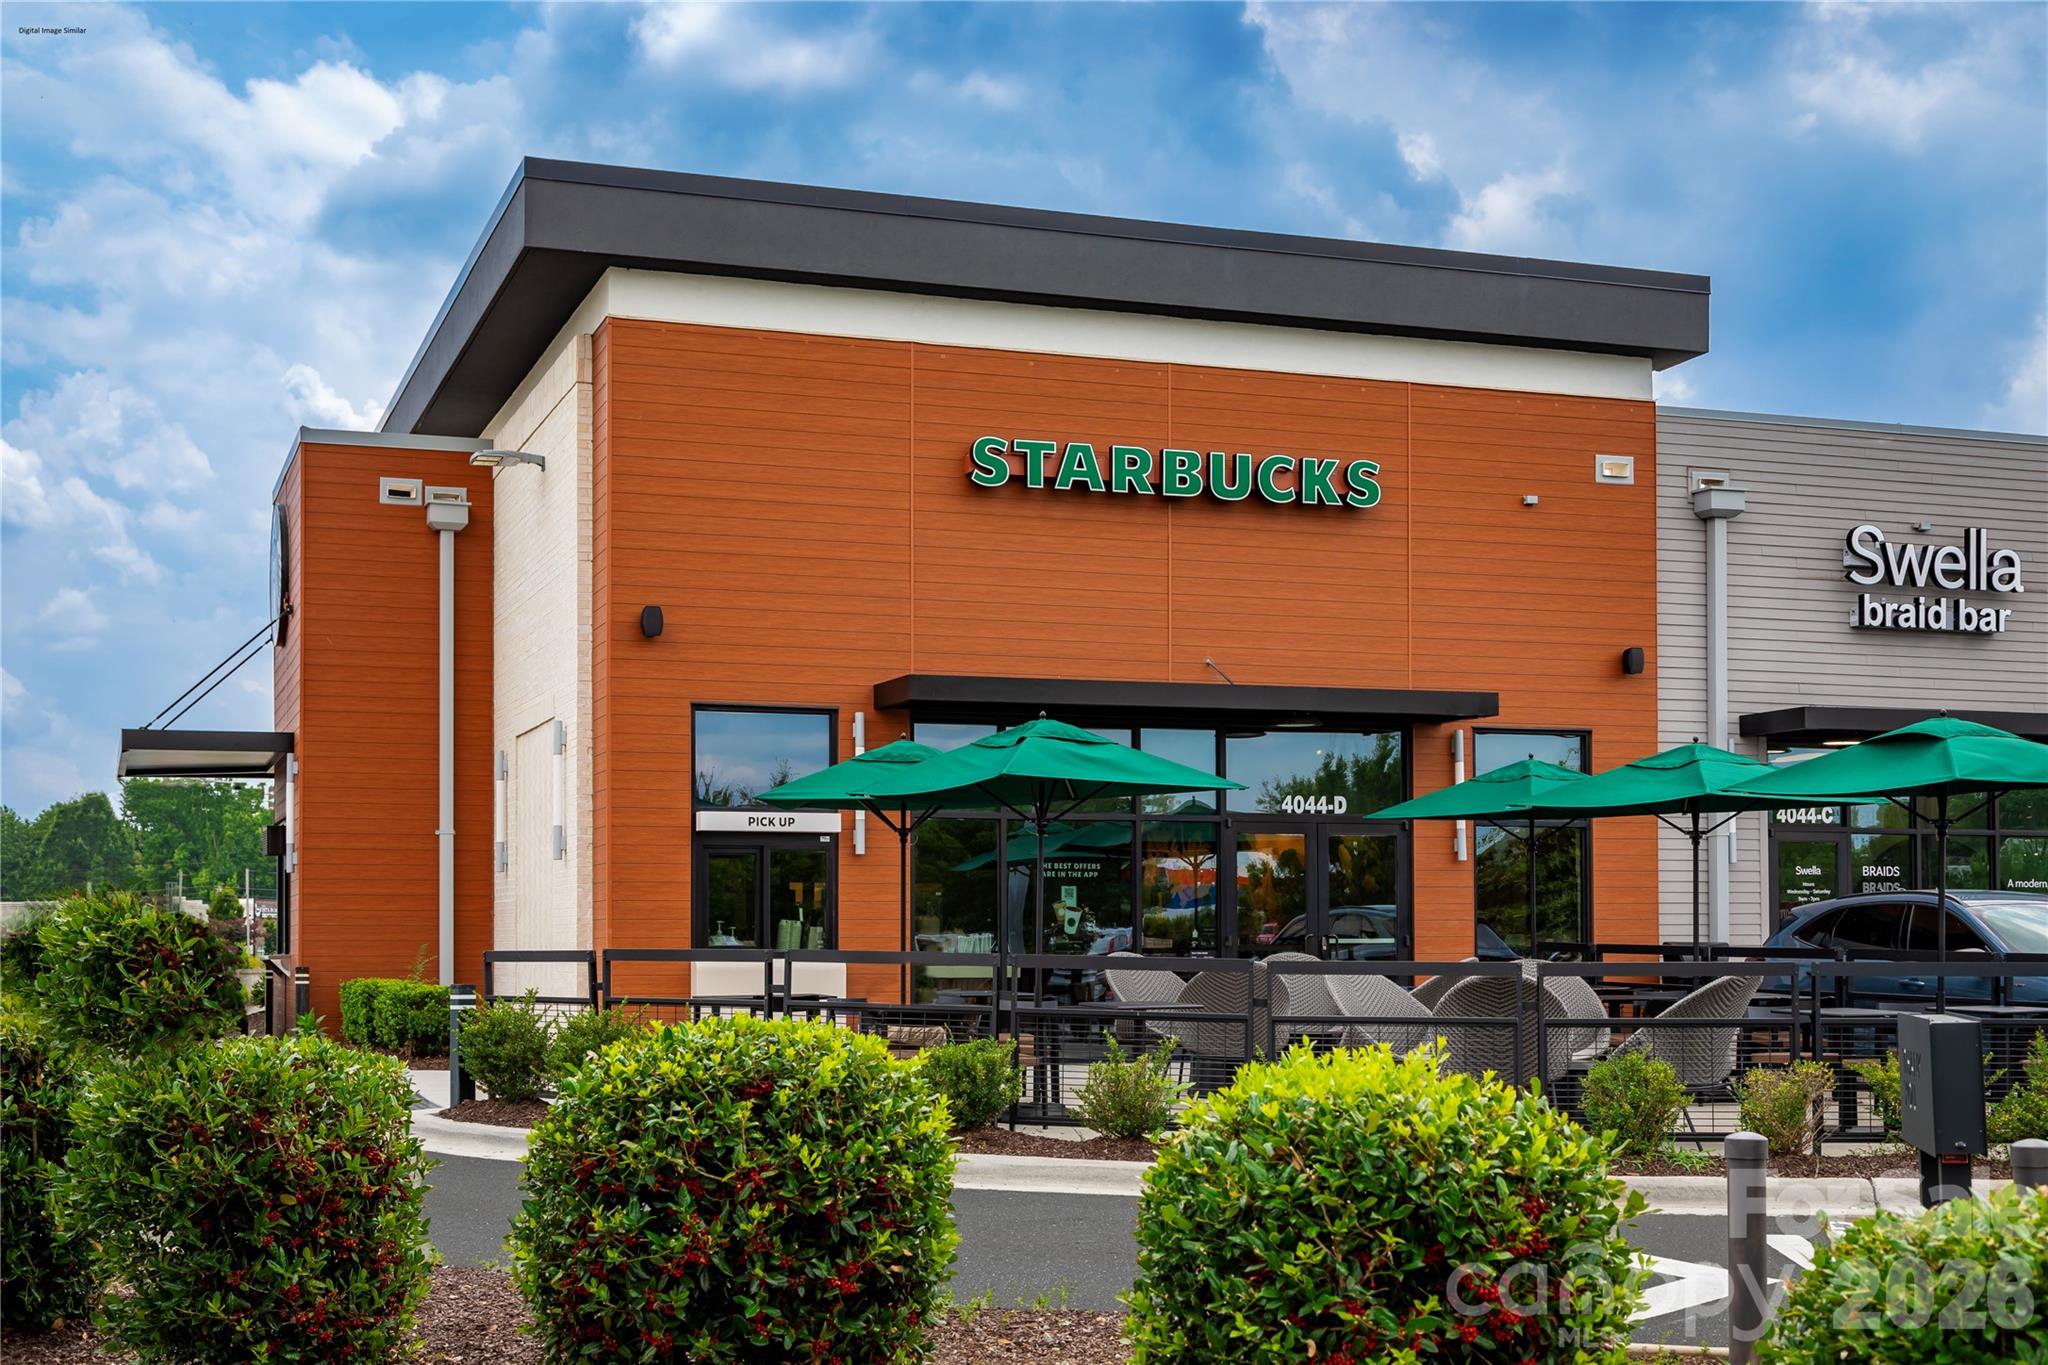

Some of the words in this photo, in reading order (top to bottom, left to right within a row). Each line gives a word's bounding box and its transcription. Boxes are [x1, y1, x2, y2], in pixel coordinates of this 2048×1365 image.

[970, 435, 1382, 508] STARBUCKS
[1846, 524, 2025, 593] Swella
[1861, 593, 1947, 630] braid
[1957, 598, 2012, 633] bar
[1281, 794, 1348, 815] 4044-D
[748, 816, 776, 827] PICK
[779, 817, 796, 827] UP
[1776, 806, 1834, 825] 4044-C
[1795, 865, 1822, 875] Swella
[1862, 865, 1901, 877] BRAIDS
[1862, 881, 1901, 893] BRAIDS
[2007, 878, 2015, 888] A
